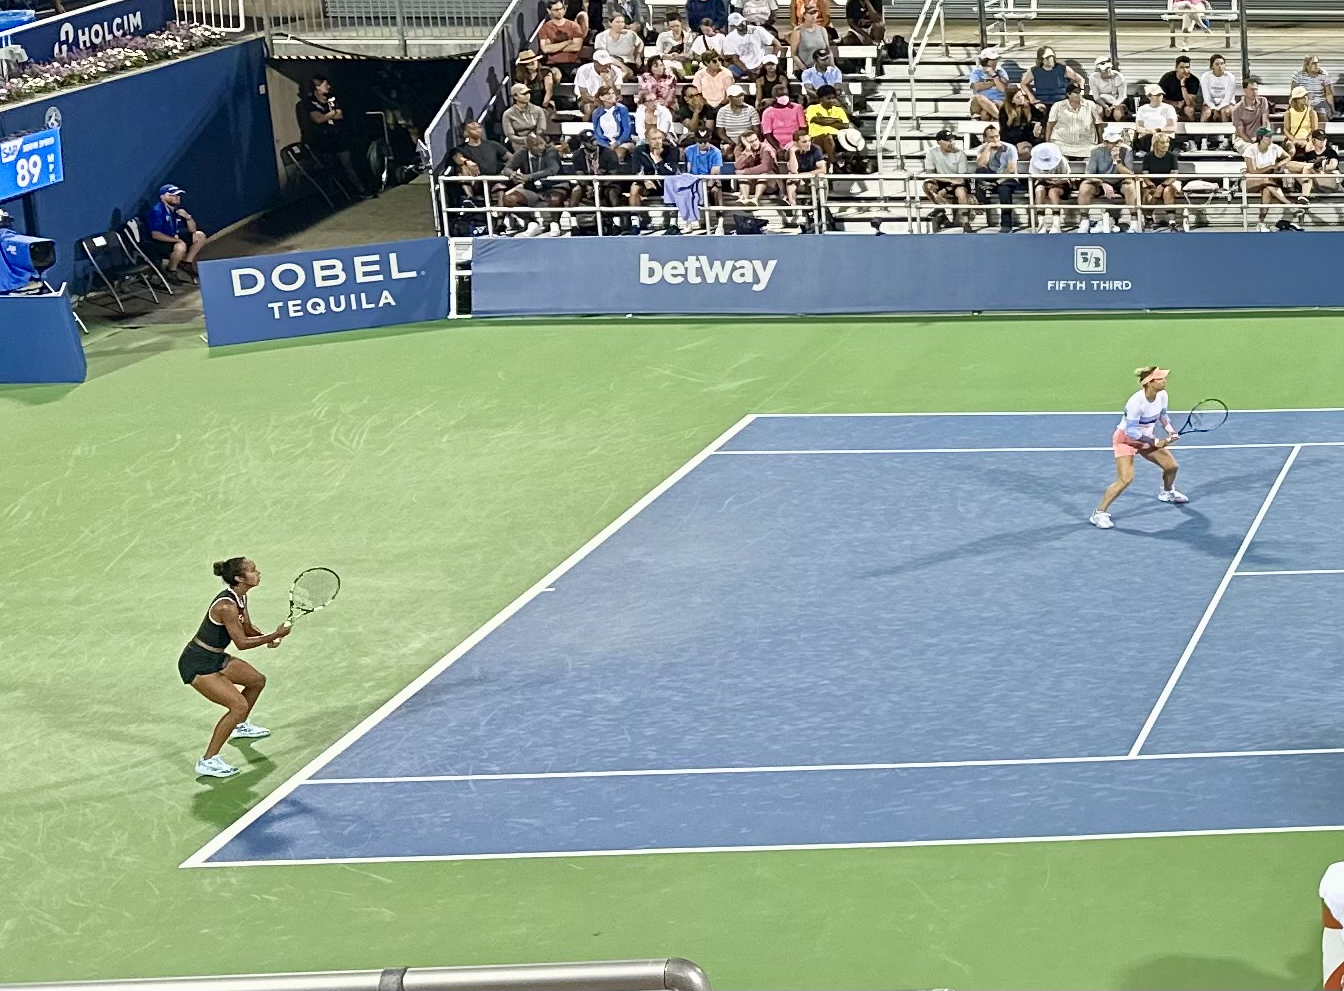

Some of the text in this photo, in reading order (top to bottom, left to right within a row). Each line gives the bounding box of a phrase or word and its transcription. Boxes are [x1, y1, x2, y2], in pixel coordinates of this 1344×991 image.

[78, 11, 143, 49] HOLCIM
[16, 154, 42, 188] 89
[231, 253, 418, 297] DOBEL
[639, 253, 778, 292] betway
[1047, 280, 1132, 291] FIFTH THIRD
[267, 289, 396, 319] TEQUILA
